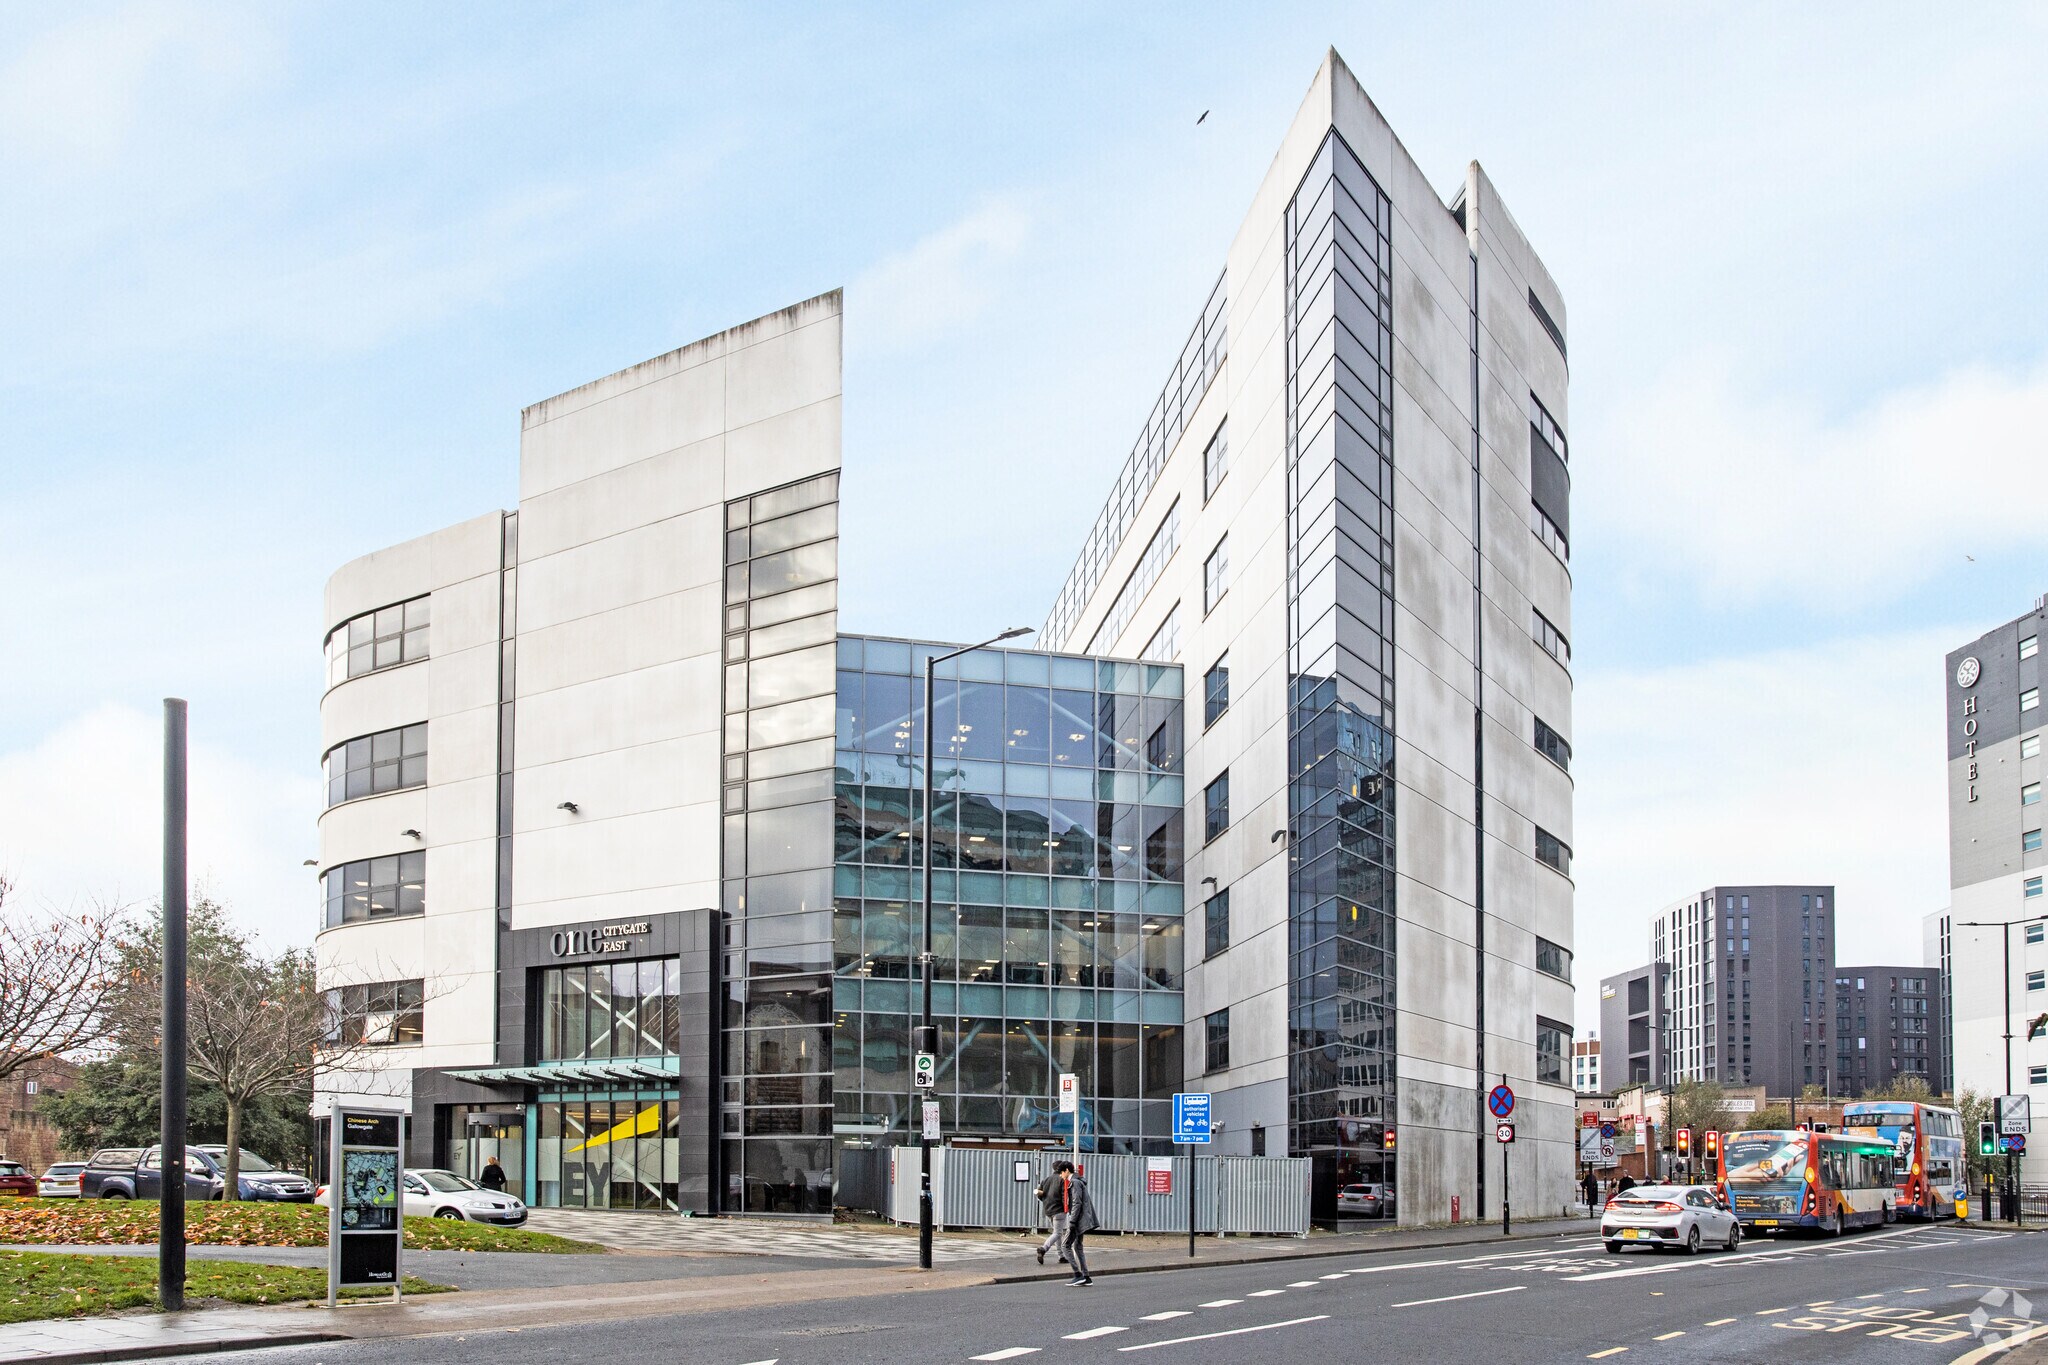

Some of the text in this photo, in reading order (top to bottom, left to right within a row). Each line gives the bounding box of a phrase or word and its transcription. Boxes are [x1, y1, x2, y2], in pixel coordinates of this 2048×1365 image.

[1963, 696, 1978, 802] HOTEL
[603, 922, 648, 937] CITYGATE
[549, 928, 603, 957] one
[603, 941, 627, 953] EAST
[1760, 1161, 1772, 1170] 63
[564, 1162, 614, 1207] EY
